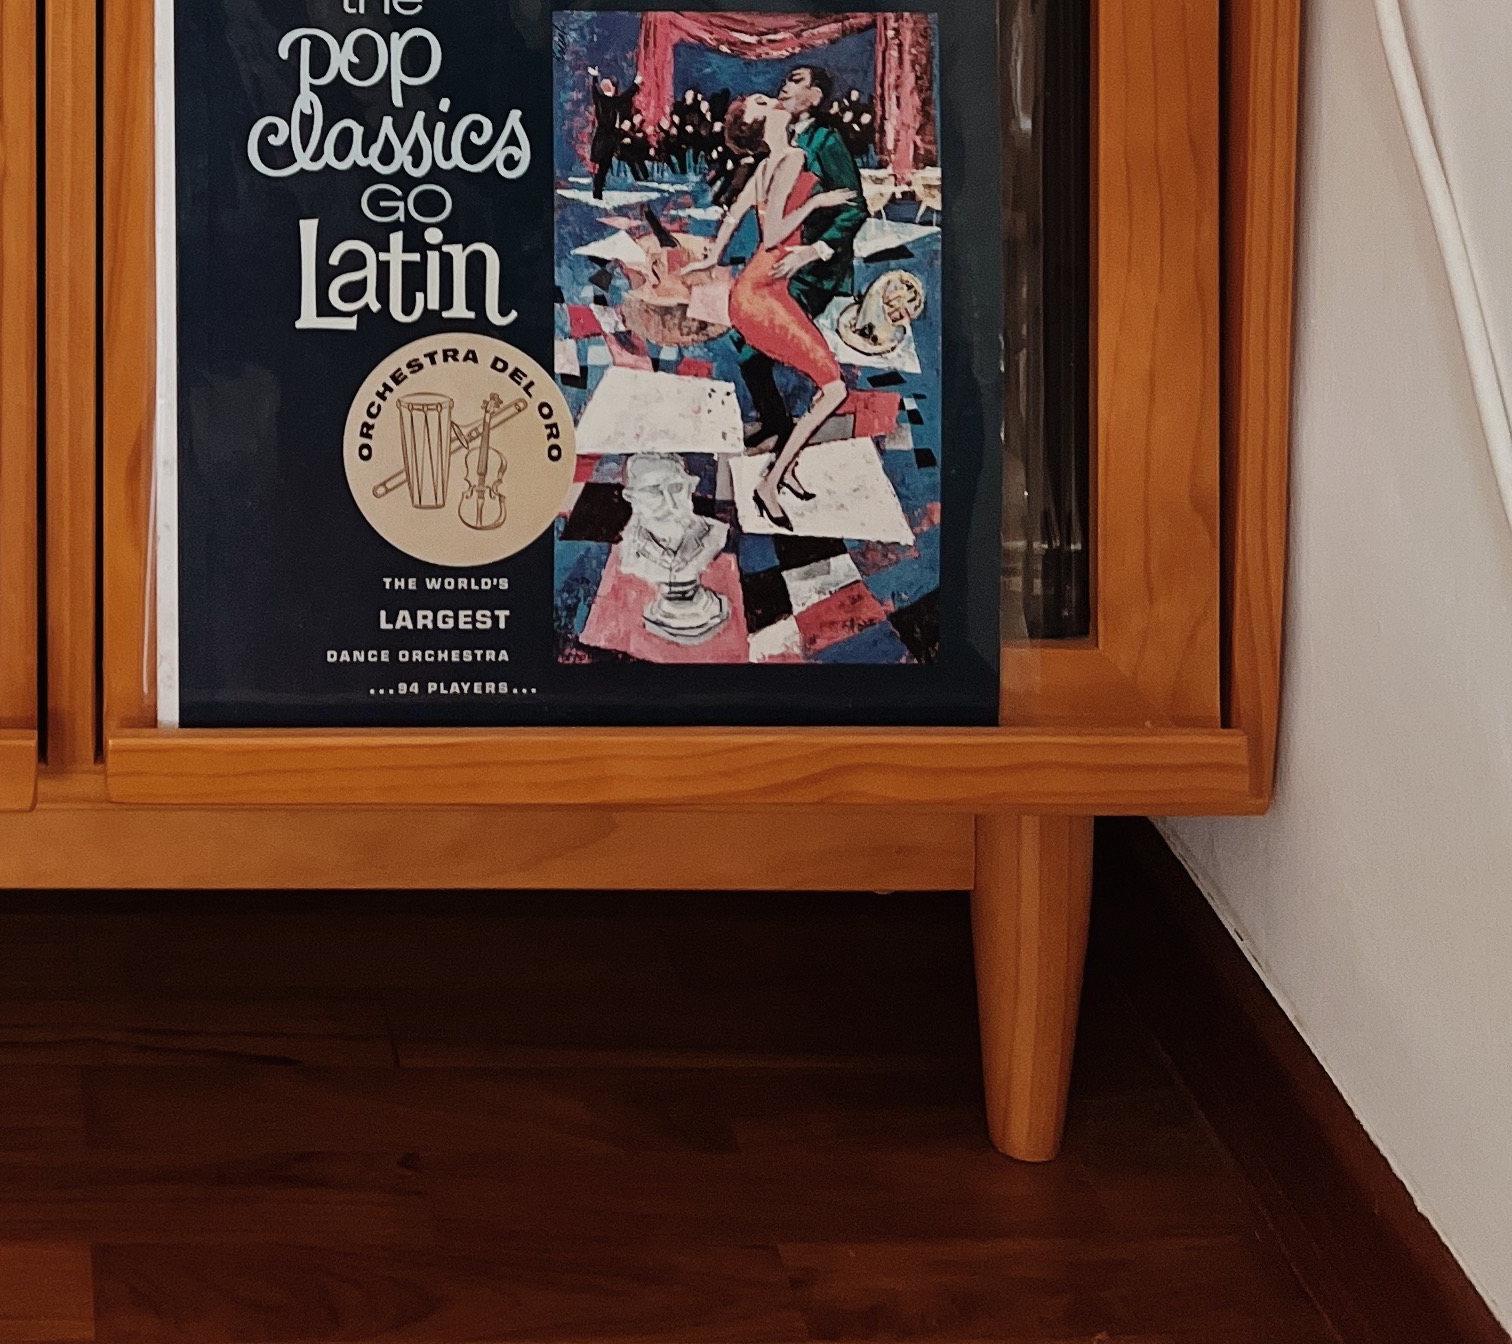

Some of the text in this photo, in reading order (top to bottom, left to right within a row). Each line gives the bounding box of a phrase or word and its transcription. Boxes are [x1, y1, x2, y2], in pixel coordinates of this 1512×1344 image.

[278, 27, 442, 107] pop
[247, 92, 531, 179] classics
[361, 183, 453, 225] GO
[294, 217, 518, 332] Latin
[358, 348, 563, 463] ORCHESTRA DEL ORO
[383, 577, 510, 591] THE WORLD'S
[380, 610, 511, 630] LARGEST
[326, 650, 510, 663] DANCE ORCHESTRA
